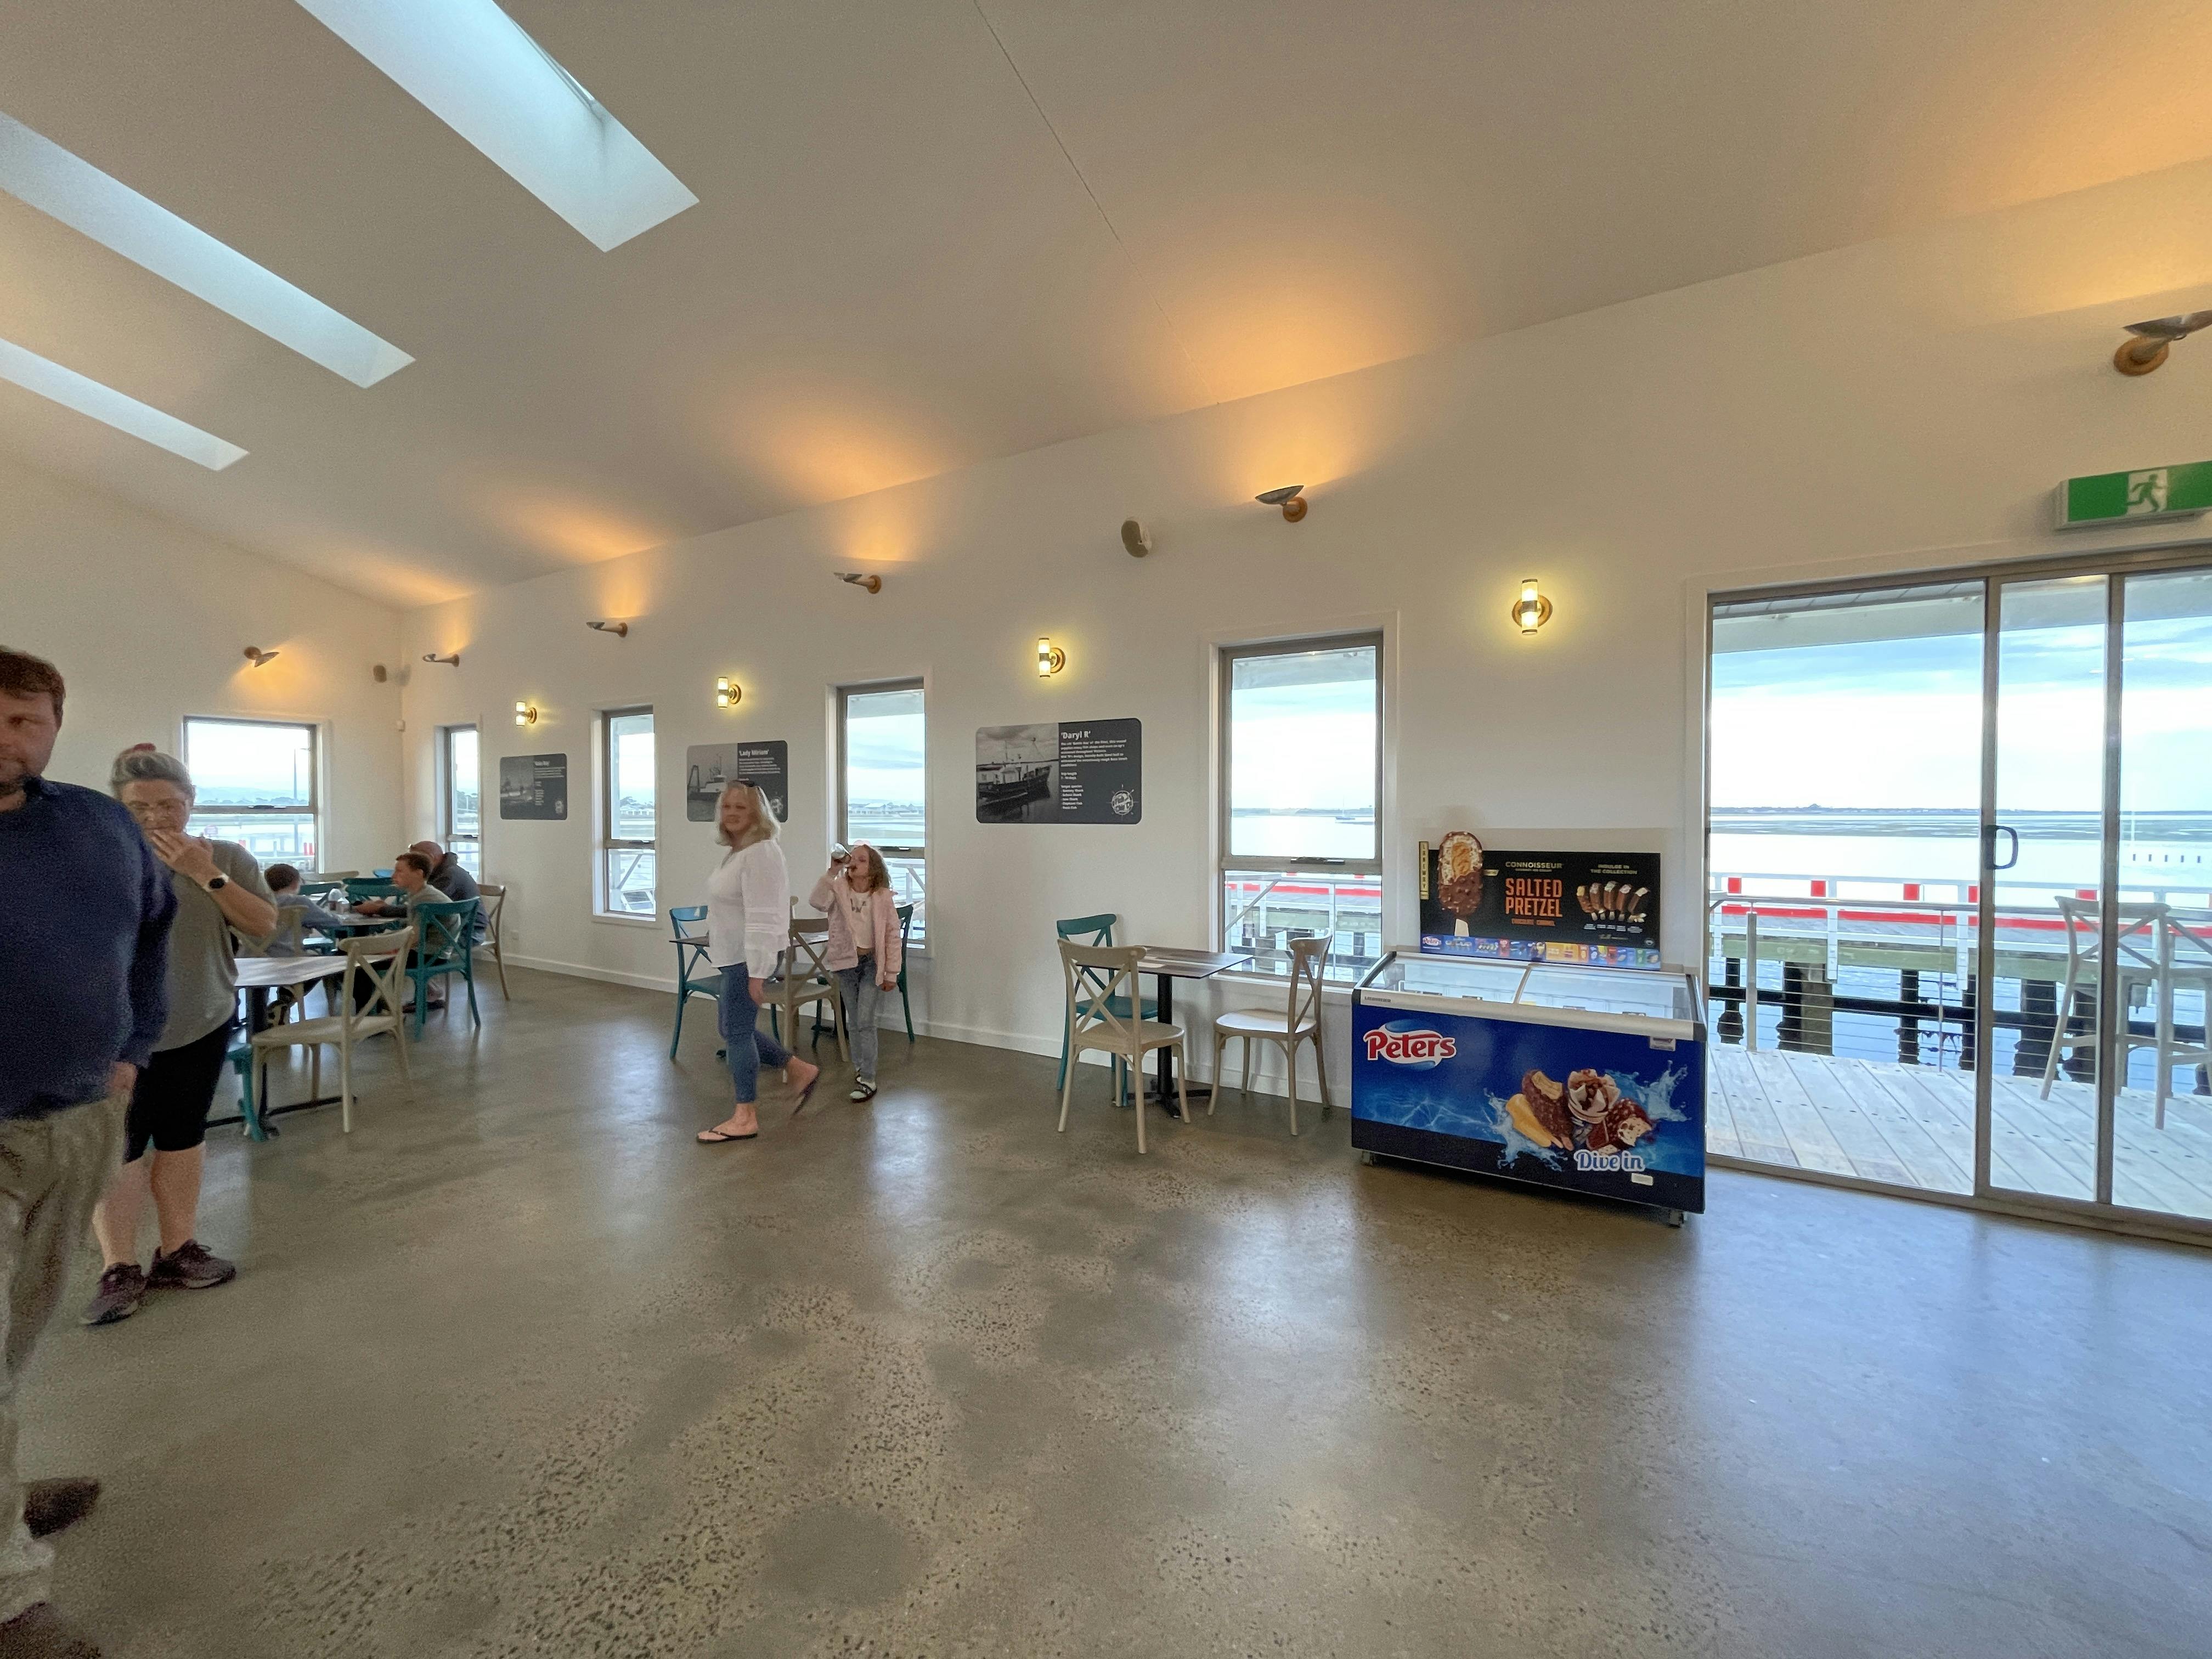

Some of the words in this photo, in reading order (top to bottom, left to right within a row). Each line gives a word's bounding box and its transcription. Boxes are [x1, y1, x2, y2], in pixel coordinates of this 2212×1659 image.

[1505, 877, 1562, 898] SALTED
[1505, 896, 1563, 918] PRETZEL
[1364, 1031, 1455, 1059] Peters
[1575, 1150, 1619, 1170] Dive
[1623, 1151, 1644, 1170] in
